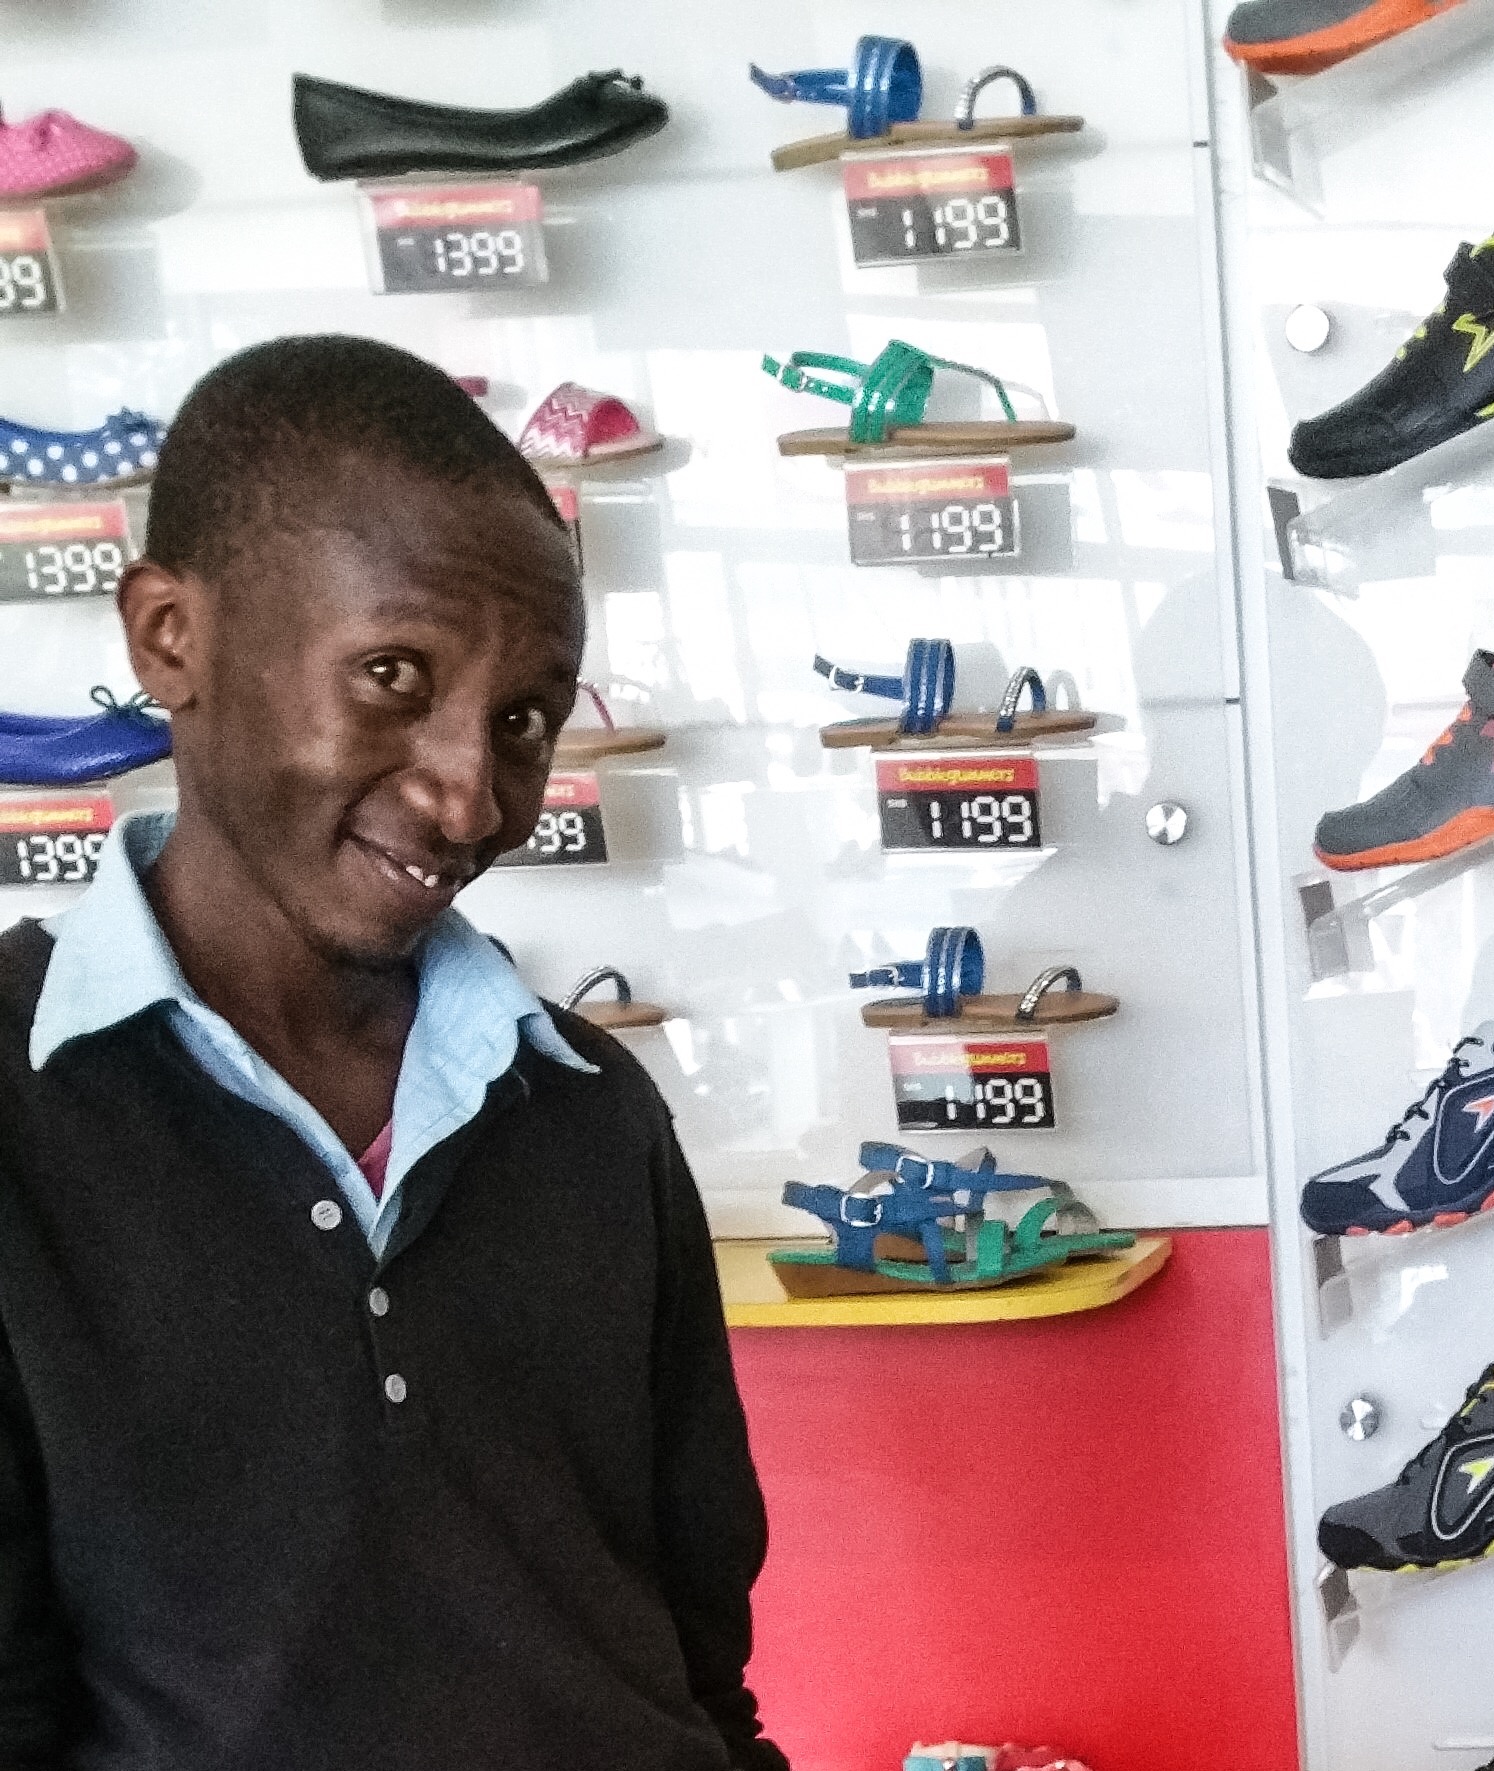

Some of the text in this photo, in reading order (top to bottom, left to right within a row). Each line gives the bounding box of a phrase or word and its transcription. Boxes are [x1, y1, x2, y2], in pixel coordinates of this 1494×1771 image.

[902, 196, 1009, 248] 1199
[434, 230, 524, 276] 1399
[900, 504, 1003, 552] 1199
[26, 542, 123, 593] 1399
[929, 795, 1032, 842] 1199
[945, 1077, 1046, 1124] 1199
